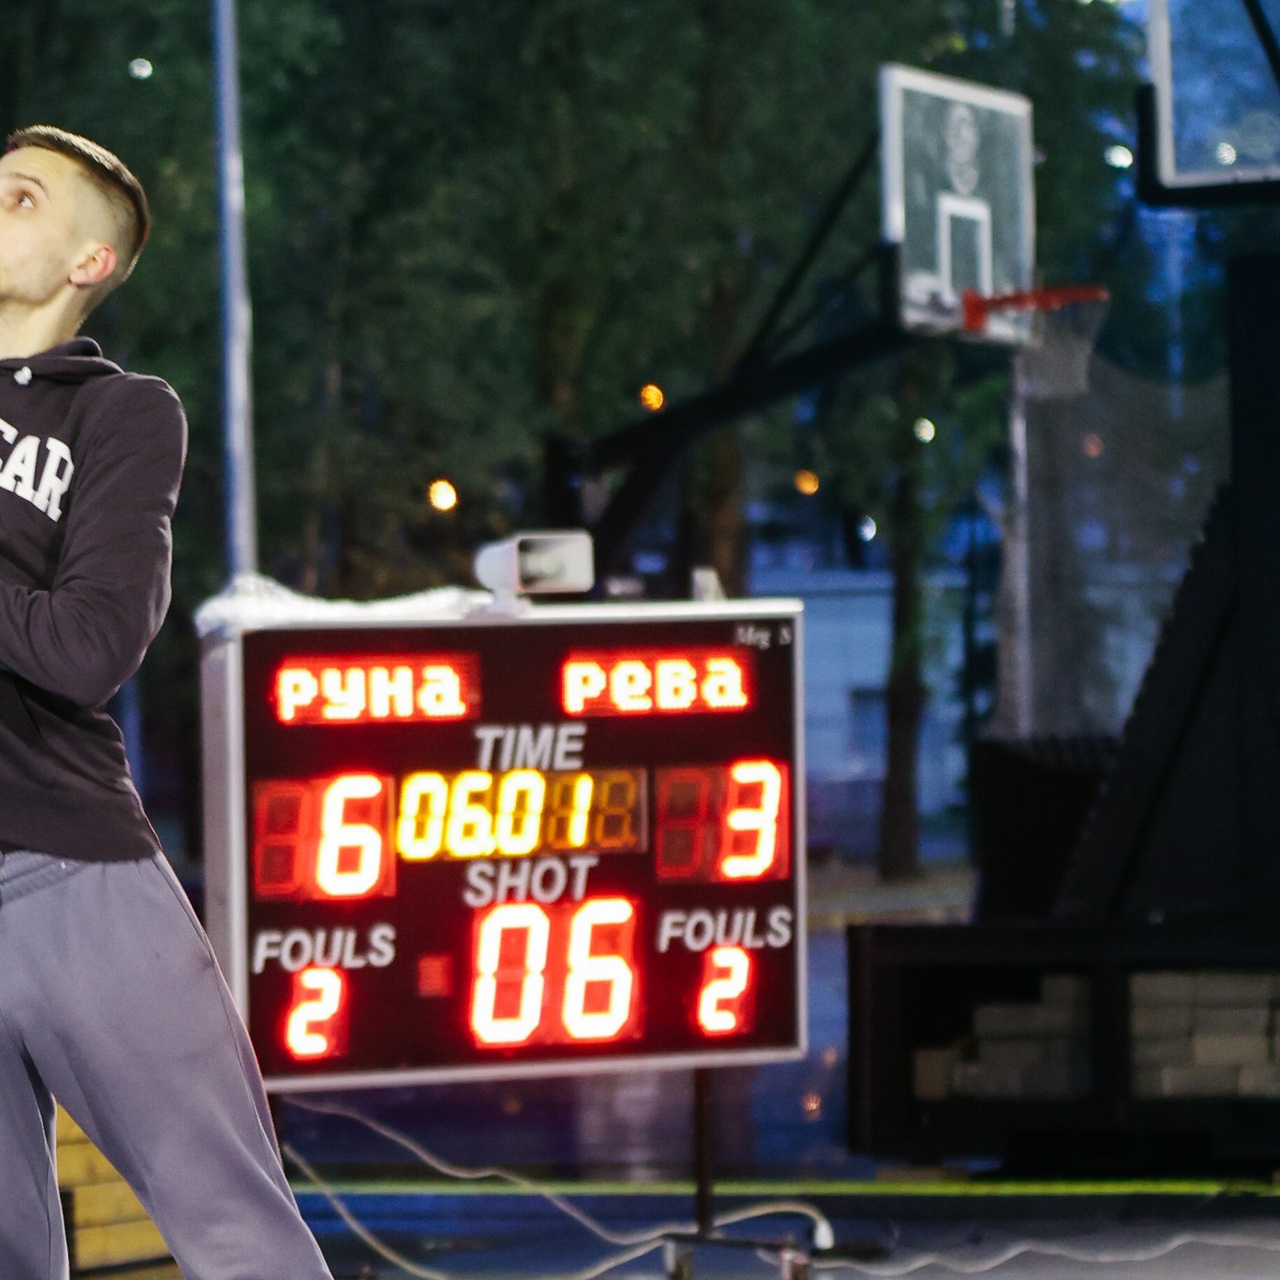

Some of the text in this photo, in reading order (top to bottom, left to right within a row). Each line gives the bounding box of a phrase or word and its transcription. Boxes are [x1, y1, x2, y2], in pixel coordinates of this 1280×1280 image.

[474, 722, 587, 771] TIME
[316, 775, 383, 896] 6
[721, 760, 782, 879] 3
[463, 854, 599, 908] SHOT
[252, 923, 396, 975] FOULS
[471, 898, 634, 1044] 06
[657, 904, 792, 954] FOULS
[286, 965, 342, 1055] 2
[698, 945, 750, 1031] 2
